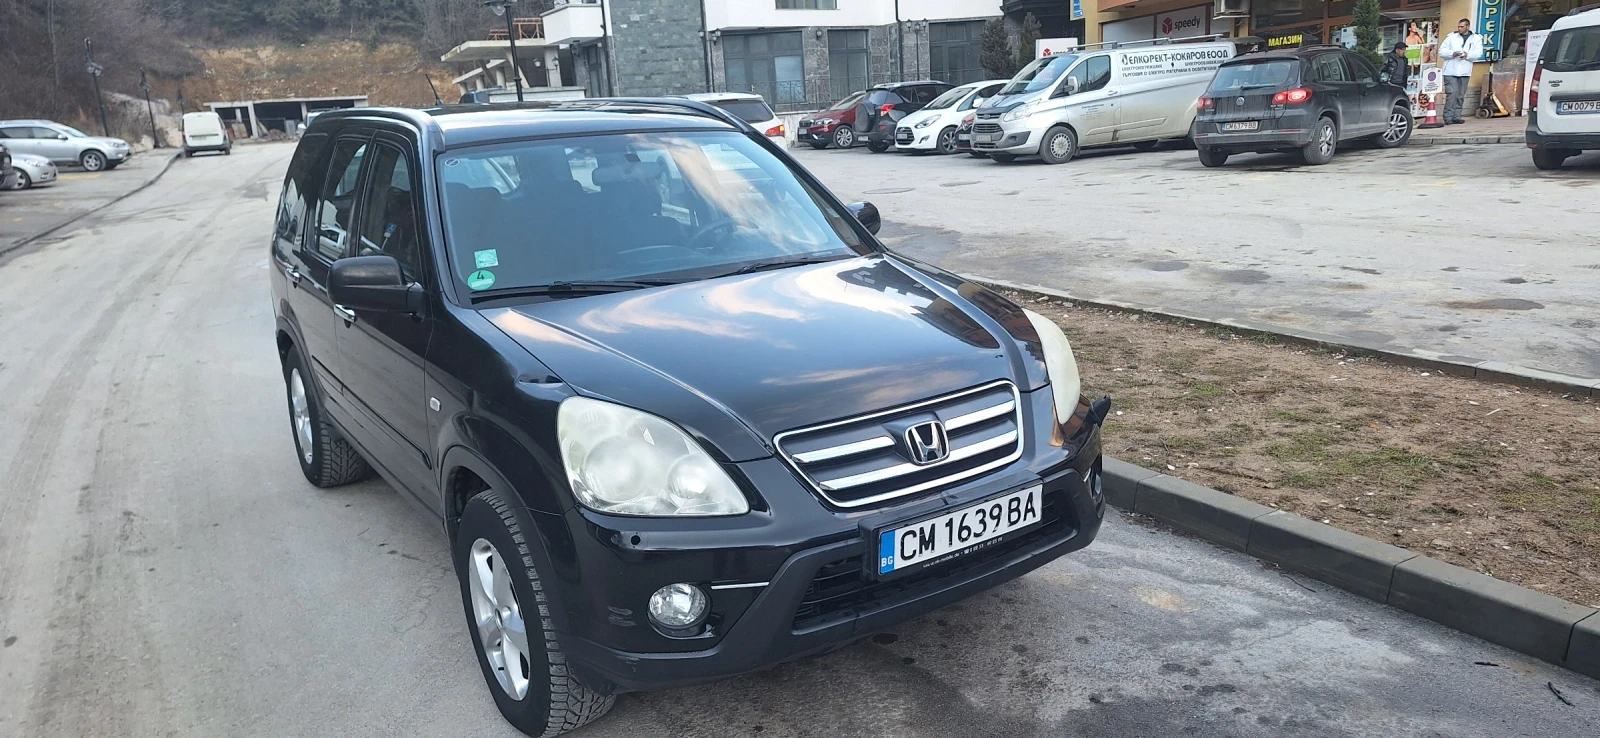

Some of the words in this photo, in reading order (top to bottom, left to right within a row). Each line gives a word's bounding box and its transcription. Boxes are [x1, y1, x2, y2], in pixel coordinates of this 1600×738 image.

[1174, 15, 1200, 31] speedy
[1268, 34, 1303, 47] МАГАЗИН
[1206, 50, 1229, 59] ЕООД
[1562, 103, 1573, 111] CM
[1574, 102, 1594, 110] 0079
[477, 271, 484, 280] 4
[900, 523, 936, 561] CM
[944, 503, 1003, 546] 1639
[1007, 491, 1036, 527] BA
[881, 555, 894, 567] BG
